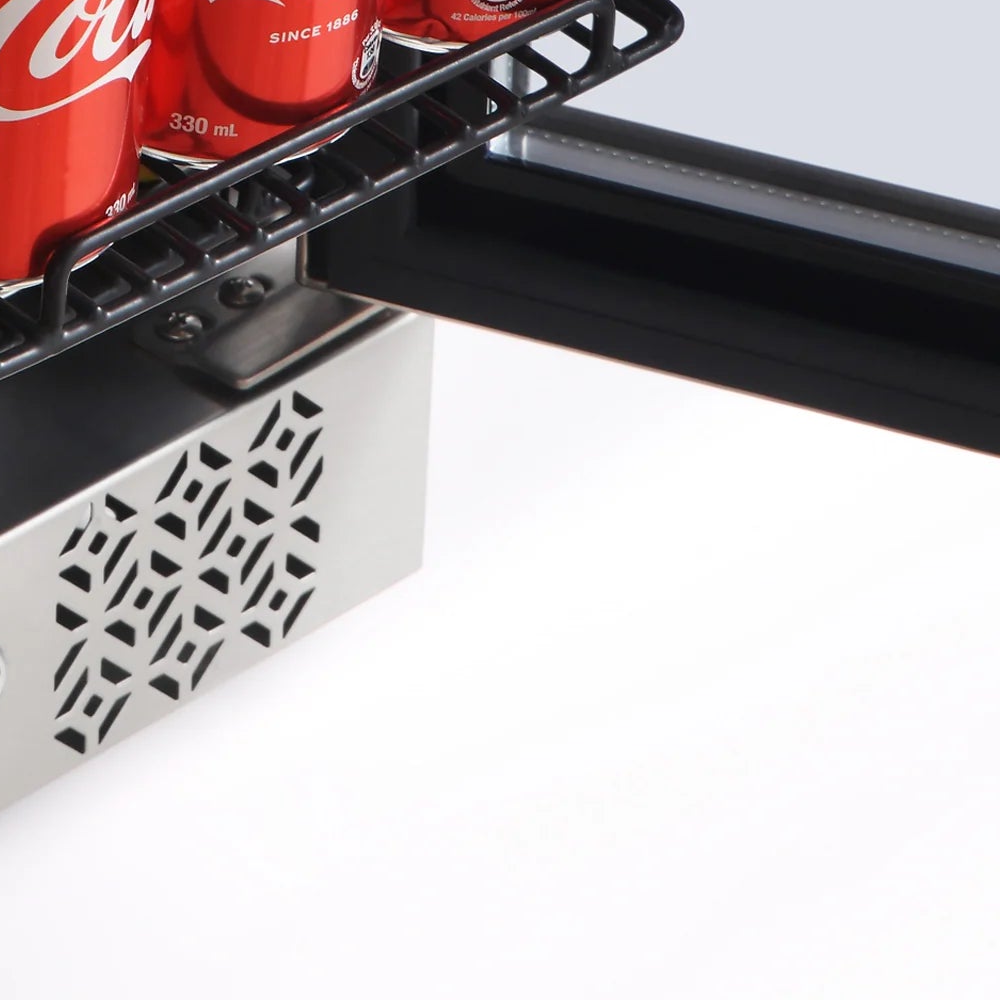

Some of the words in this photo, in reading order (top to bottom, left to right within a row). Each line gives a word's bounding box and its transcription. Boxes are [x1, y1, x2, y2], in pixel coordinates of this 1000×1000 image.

[269, 25, 321, 44] SINCE
[326, 9, 359, 32] 1886
[451, 12, 462, 21] 42
[463, 13, 497, 22] Calories
[498, 13, 512, 22] per
[169, 112, 209, 135] 330
[213, 123, 239, 137] mL
